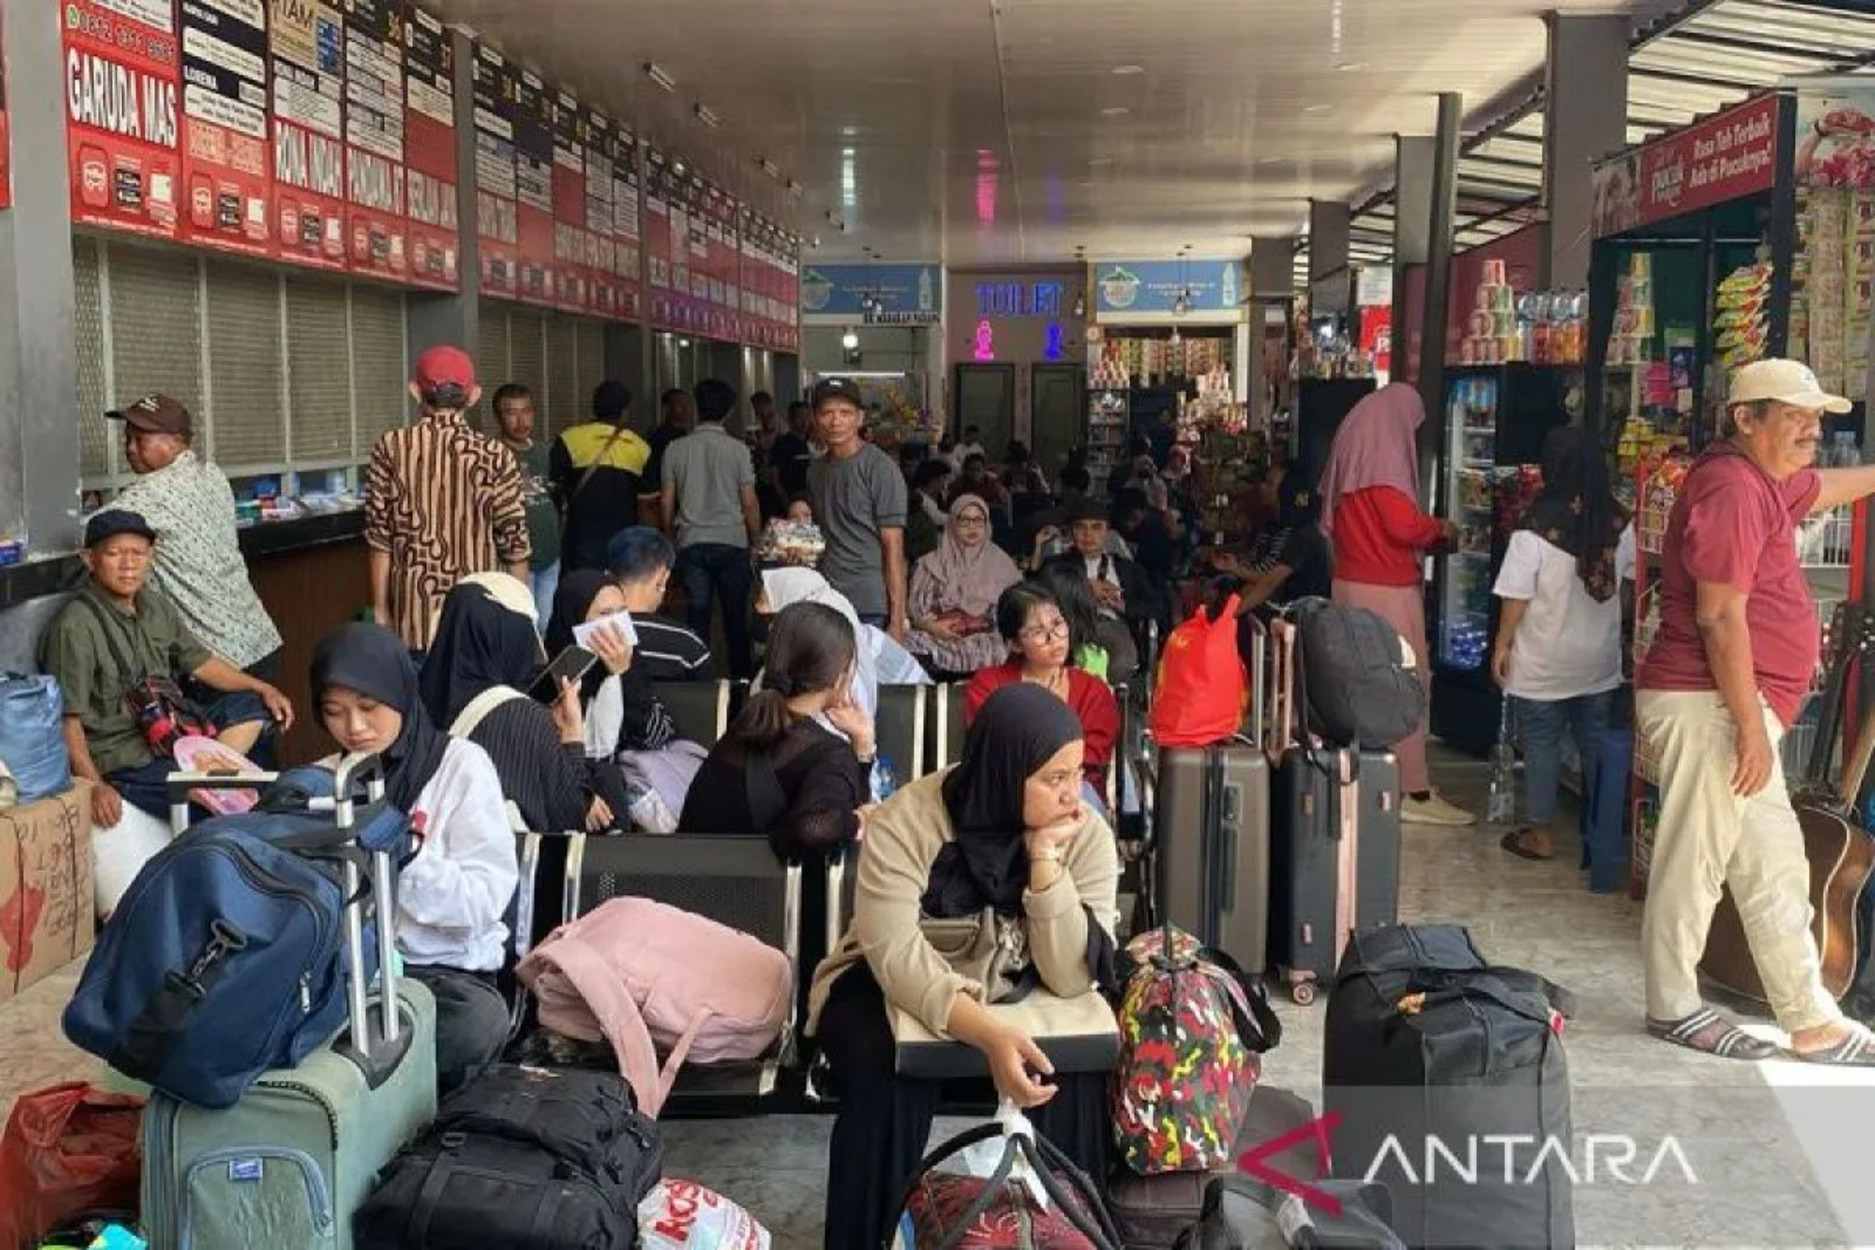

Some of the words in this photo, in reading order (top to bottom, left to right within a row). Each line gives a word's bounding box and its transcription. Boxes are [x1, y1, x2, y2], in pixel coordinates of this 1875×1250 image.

[68, 47, 141, 138] GARUDA
[142, 74, 176, 149] MAS
[974, 281, 1064, 318] TOILET
